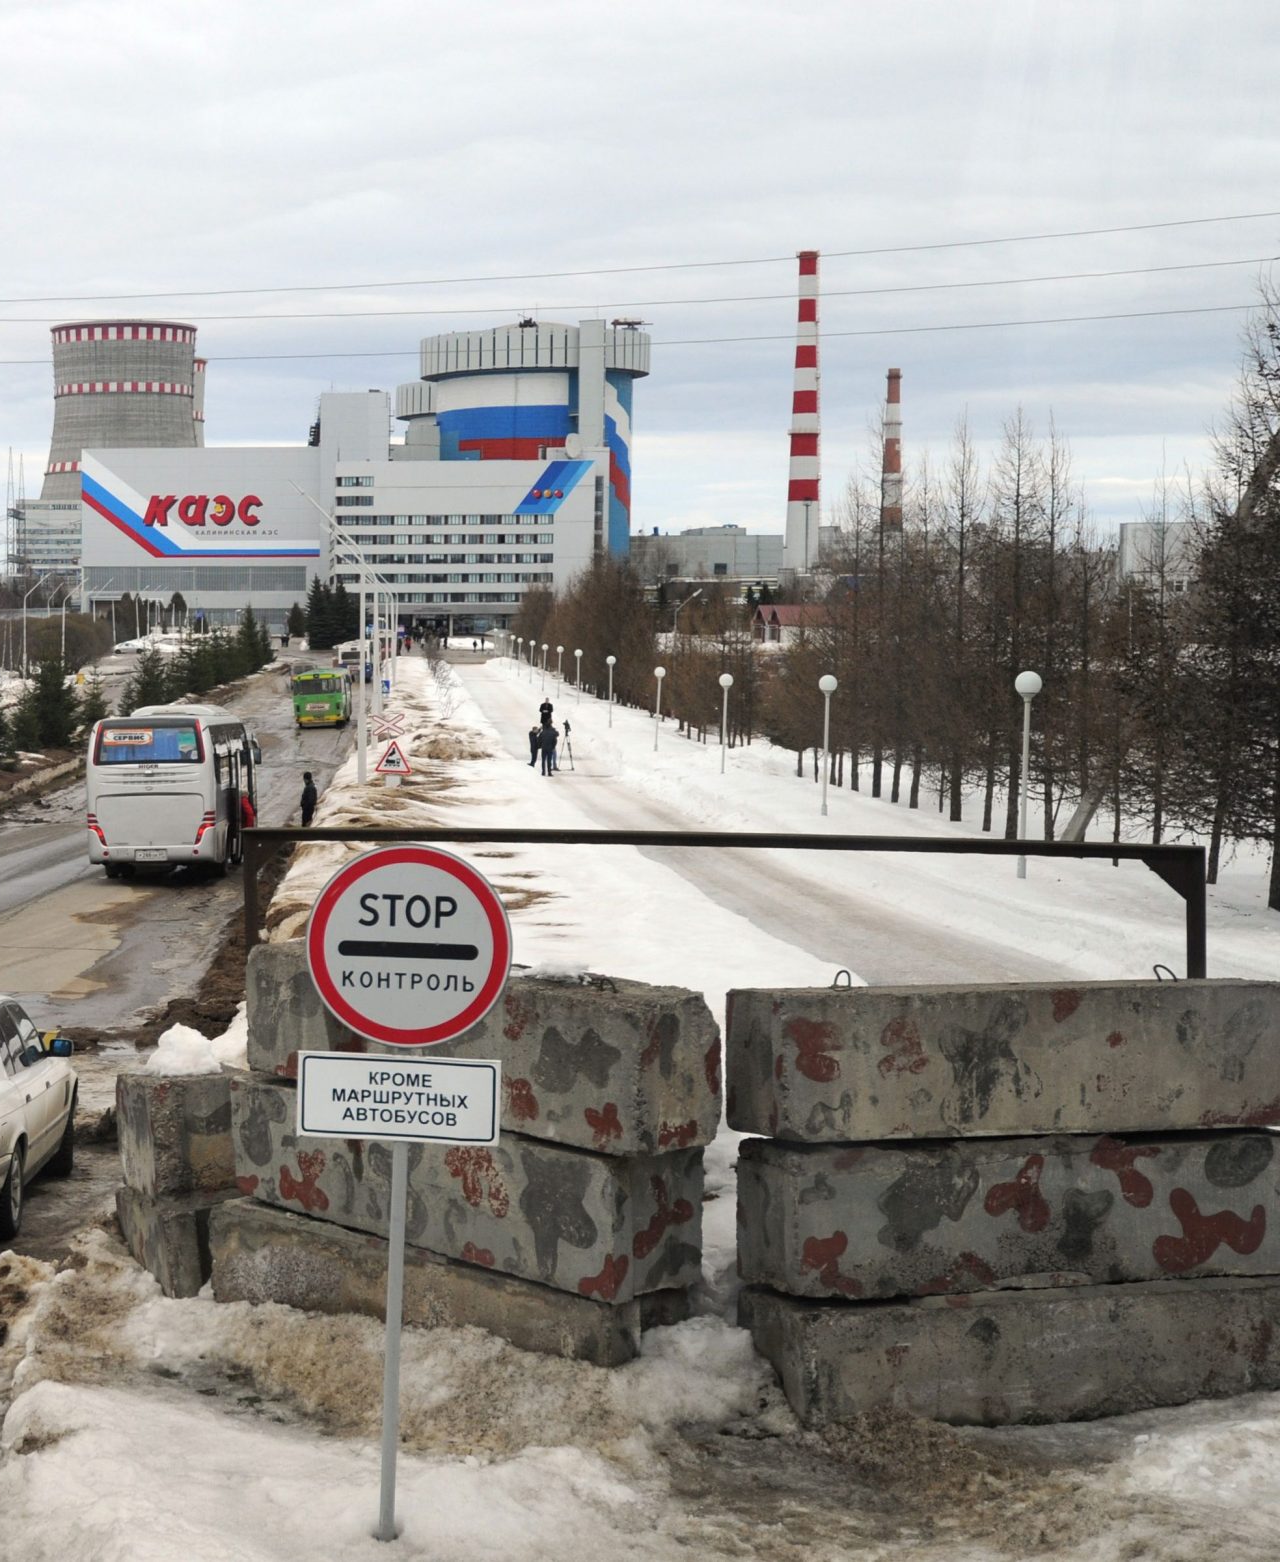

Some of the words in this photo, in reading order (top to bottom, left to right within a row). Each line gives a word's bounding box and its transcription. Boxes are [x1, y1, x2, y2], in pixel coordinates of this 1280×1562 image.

[358, 893, 458, 928] STOP
[342, 970, 475, 993] КОНТРОЛЬ
[369, 1071, 432, 1088] КРОМЕ
[332, 1088, 469, 1109] МАРШРУТНЫХ
[342, 1107, 457, 1127] АВТОБУСОВ
